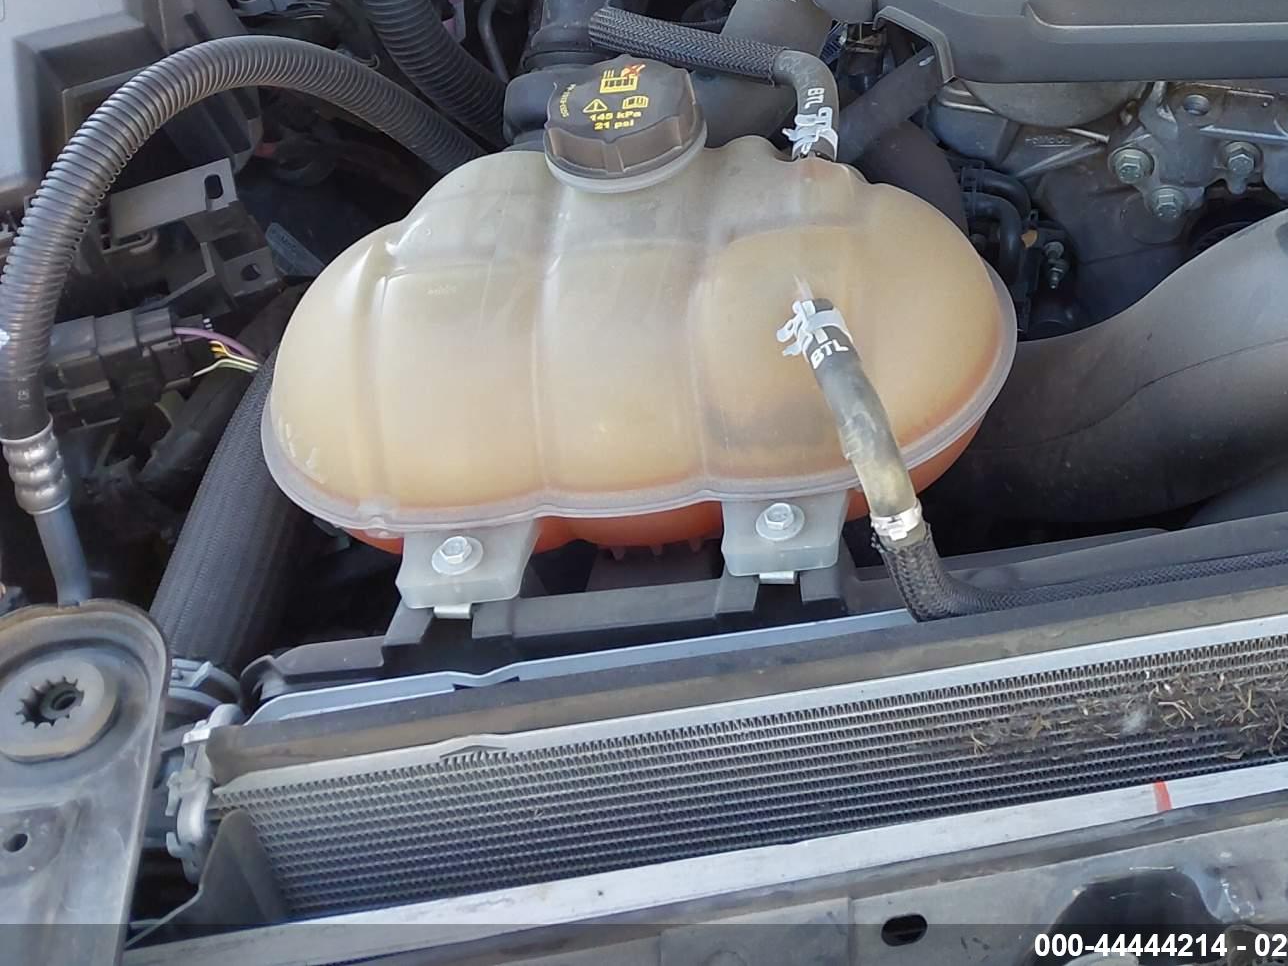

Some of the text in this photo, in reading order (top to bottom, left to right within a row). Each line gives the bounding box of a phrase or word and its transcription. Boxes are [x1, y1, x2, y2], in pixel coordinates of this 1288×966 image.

[804, 87, 825, 110] BTL
[616, 111, 641, 120] kPa
[594, 121, 610, 130] 21
[810, 338, 849, 370] BTL
